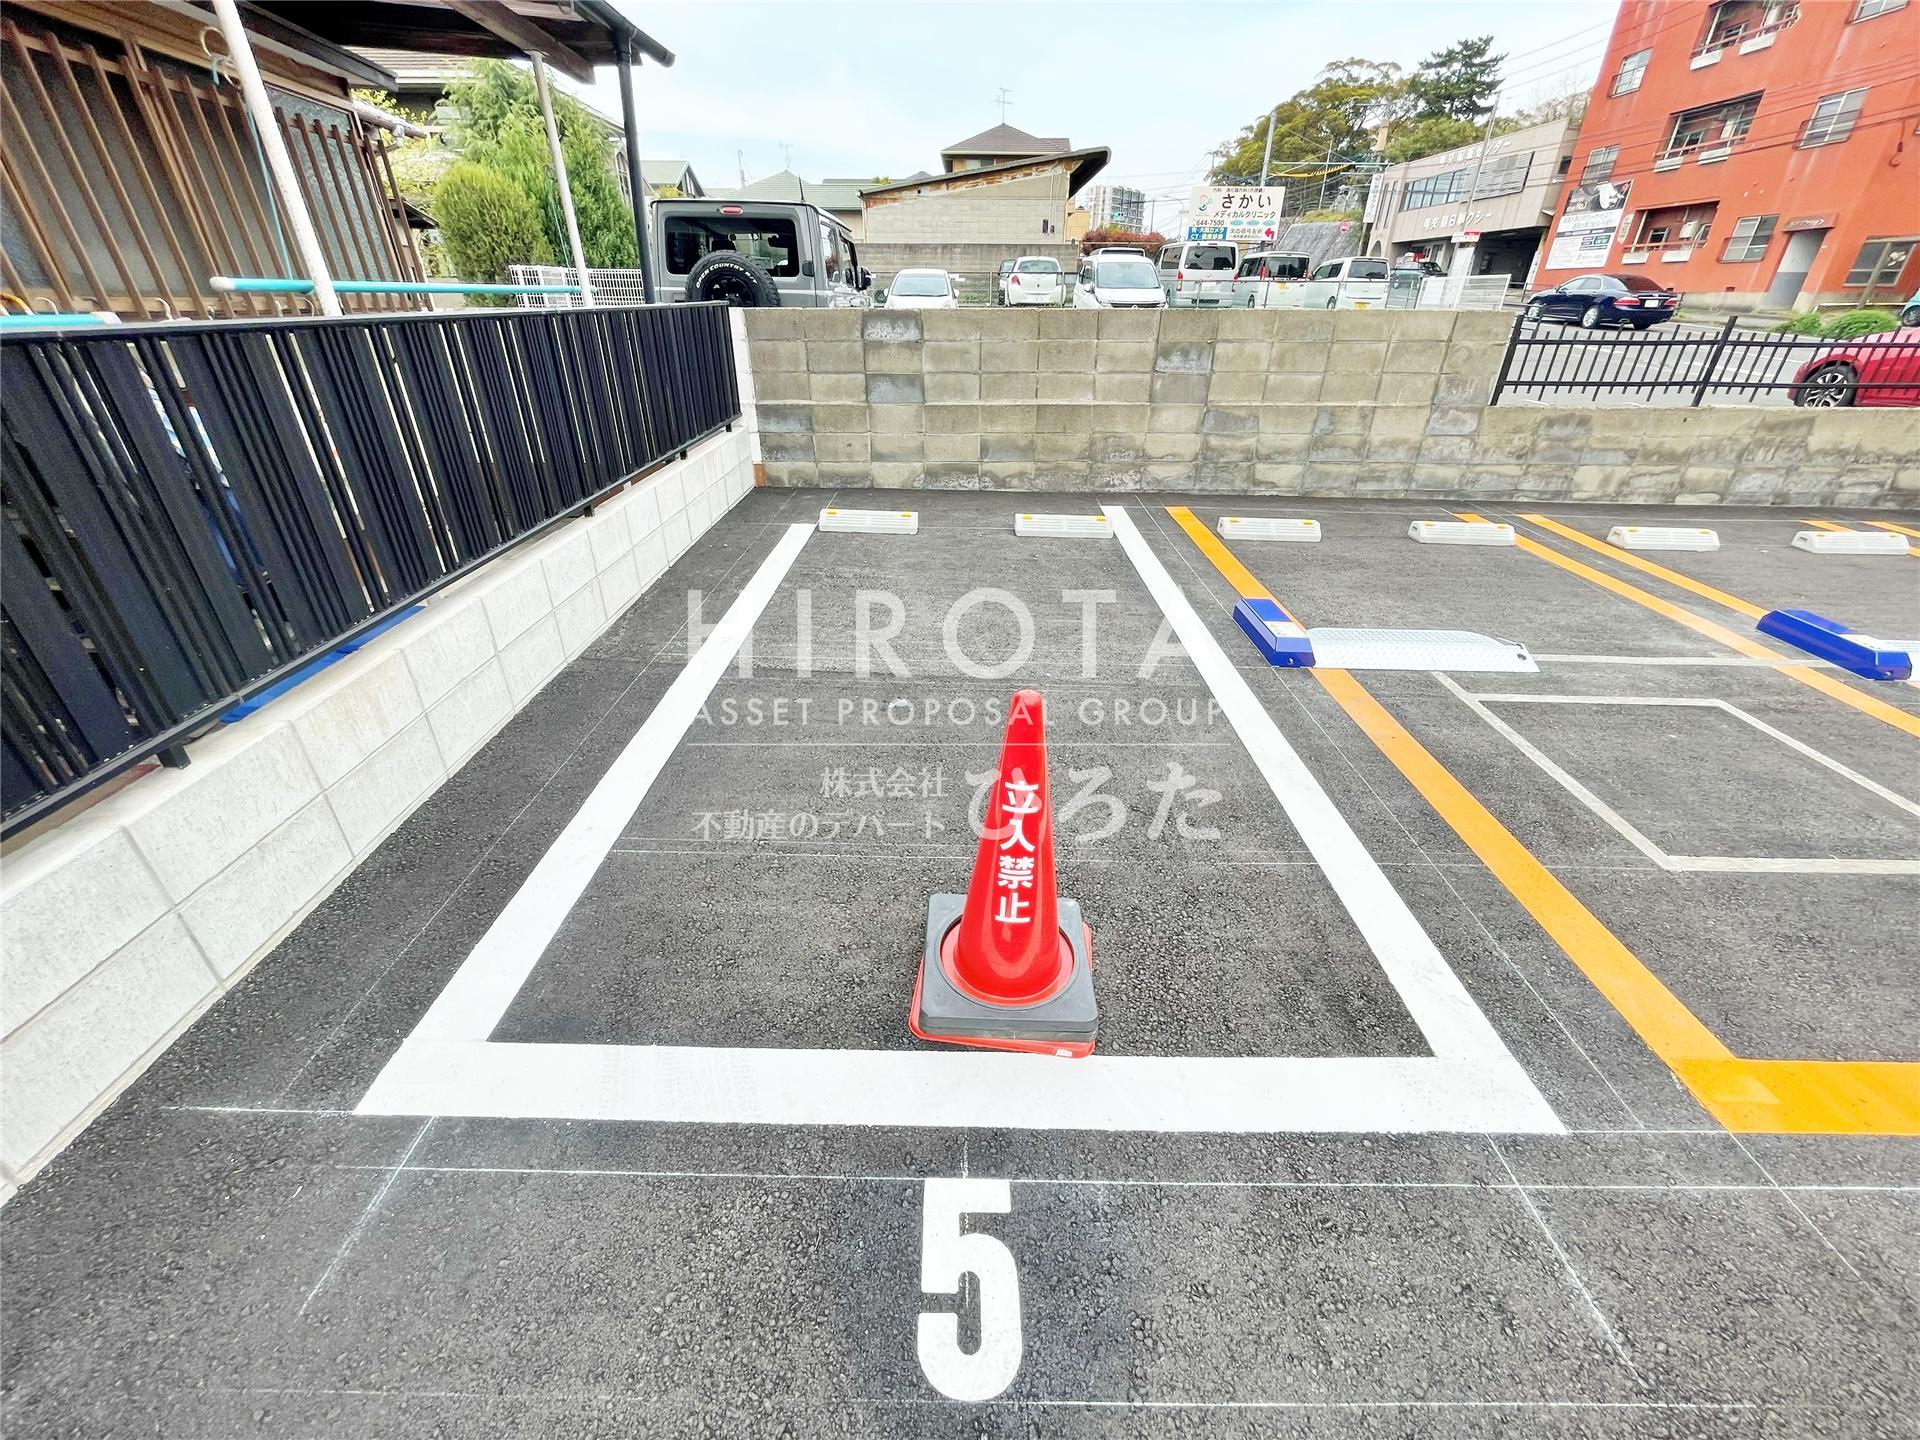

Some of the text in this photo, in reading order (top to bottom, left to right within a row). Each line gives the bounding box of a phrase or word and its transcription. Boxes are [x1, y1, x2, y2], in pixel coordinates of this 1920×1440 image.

[1222, 193, 1271, 209] さかい
[1213, 210, 1276, 219] メディカルクリニック
[696, 268, 709, 288] OPEN
[710, 263, 745, 271] COUNTRY
[995, 780, 1039, 924] 立入禁止
[917, 1178, 1023, 1401] 5
